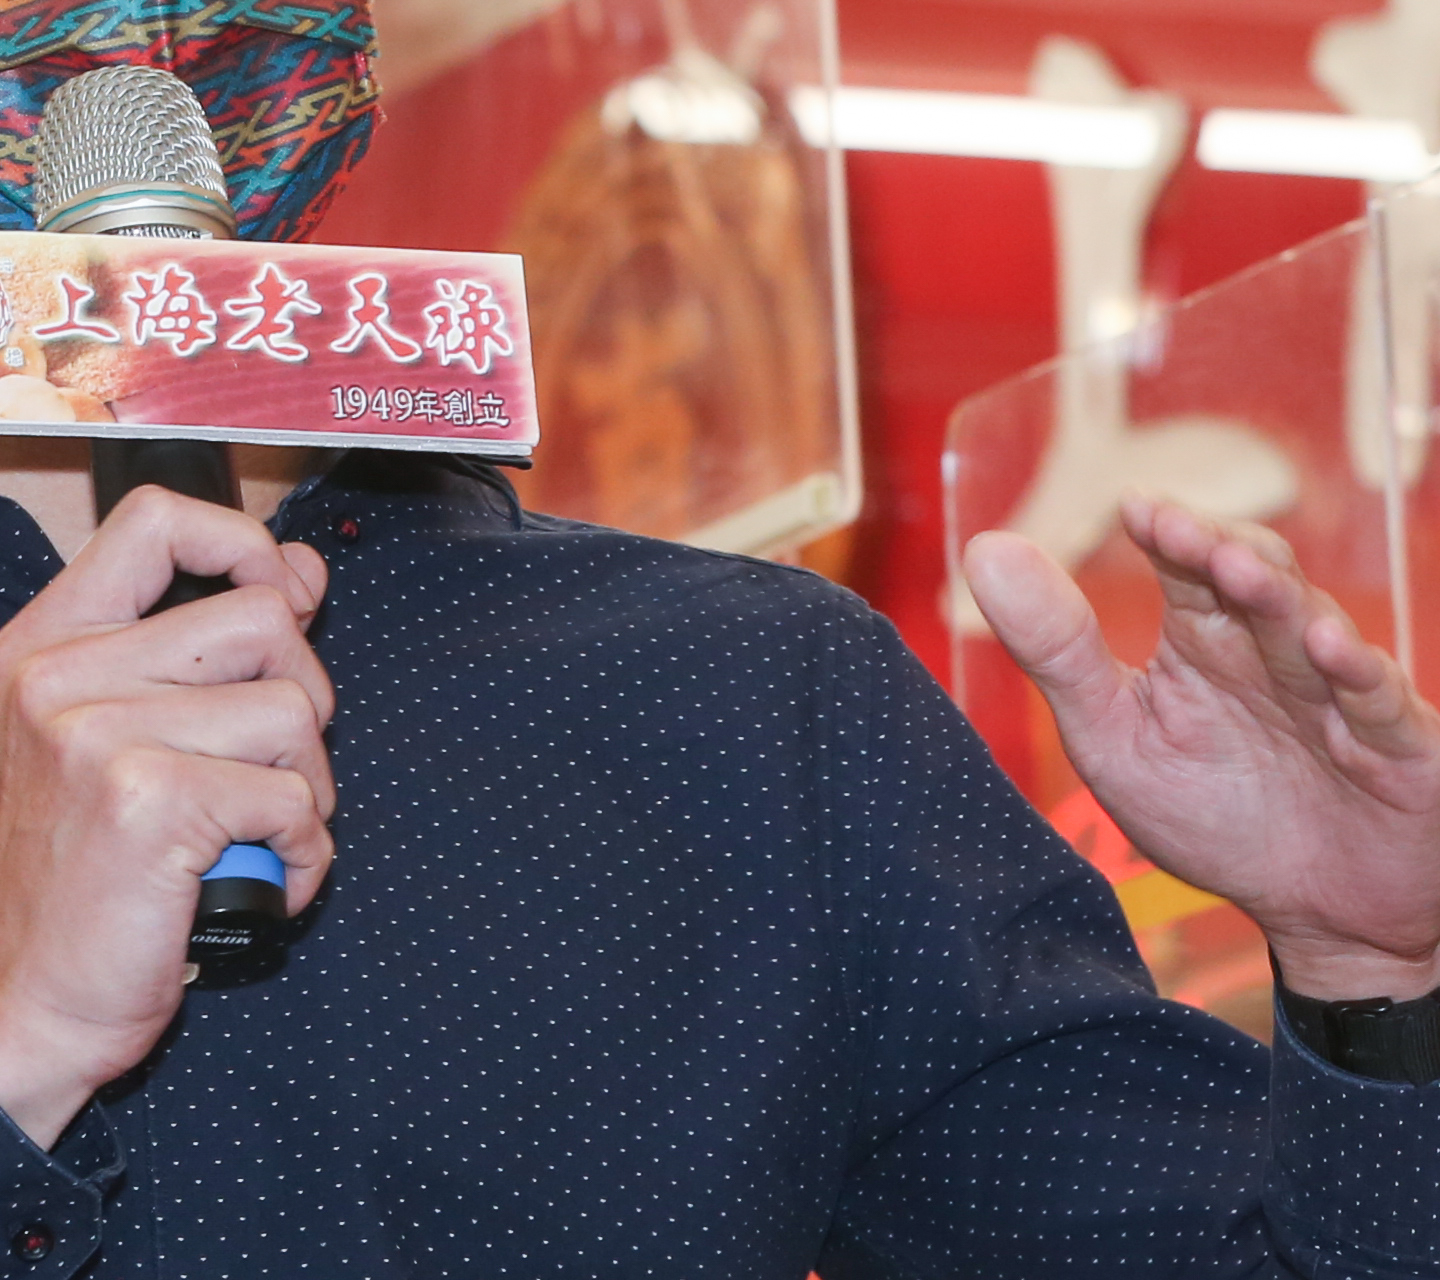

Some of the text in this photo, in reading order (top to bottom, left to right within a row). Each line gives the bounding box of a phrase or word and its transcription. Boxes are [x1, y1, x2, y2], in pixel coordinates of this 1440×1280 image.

[34, 261, 514, 375] 上海老天祿
[331, 385, 511, 428] 1949年創立
[191, 934, 253, 945] MIPRO
